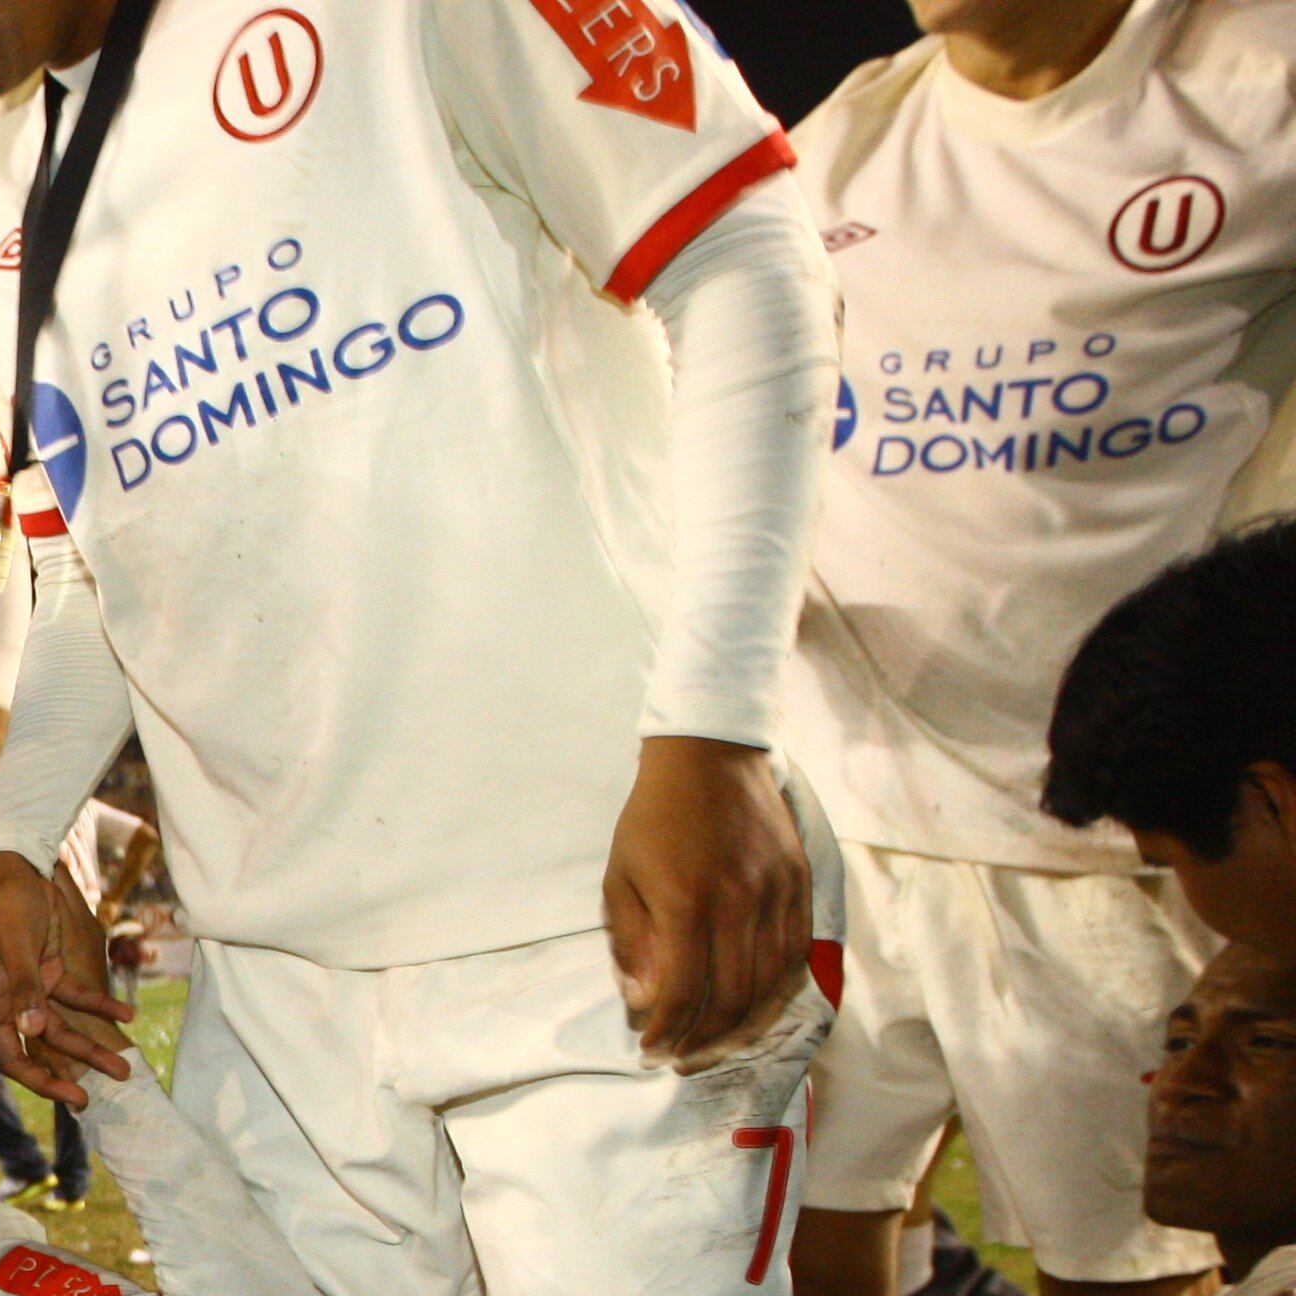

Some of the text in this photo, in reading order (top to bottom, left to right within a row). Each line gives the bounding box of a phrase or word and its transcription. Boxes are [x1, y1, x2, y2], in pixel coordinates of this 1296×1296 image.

[562, 0, 681, 102] ERS
[91, 238, 304, 372] GRUPO
[102, 287, 321, 429] SANTO
[880, 333, 1116, 374] GRUPO
[111, 293, 466, 492] DOMINGO
[871, 403, 1207, 477] DOMINGO
[883, 372, 1110, 424] SANTO
[731, 1125, 795, 1286] 7
